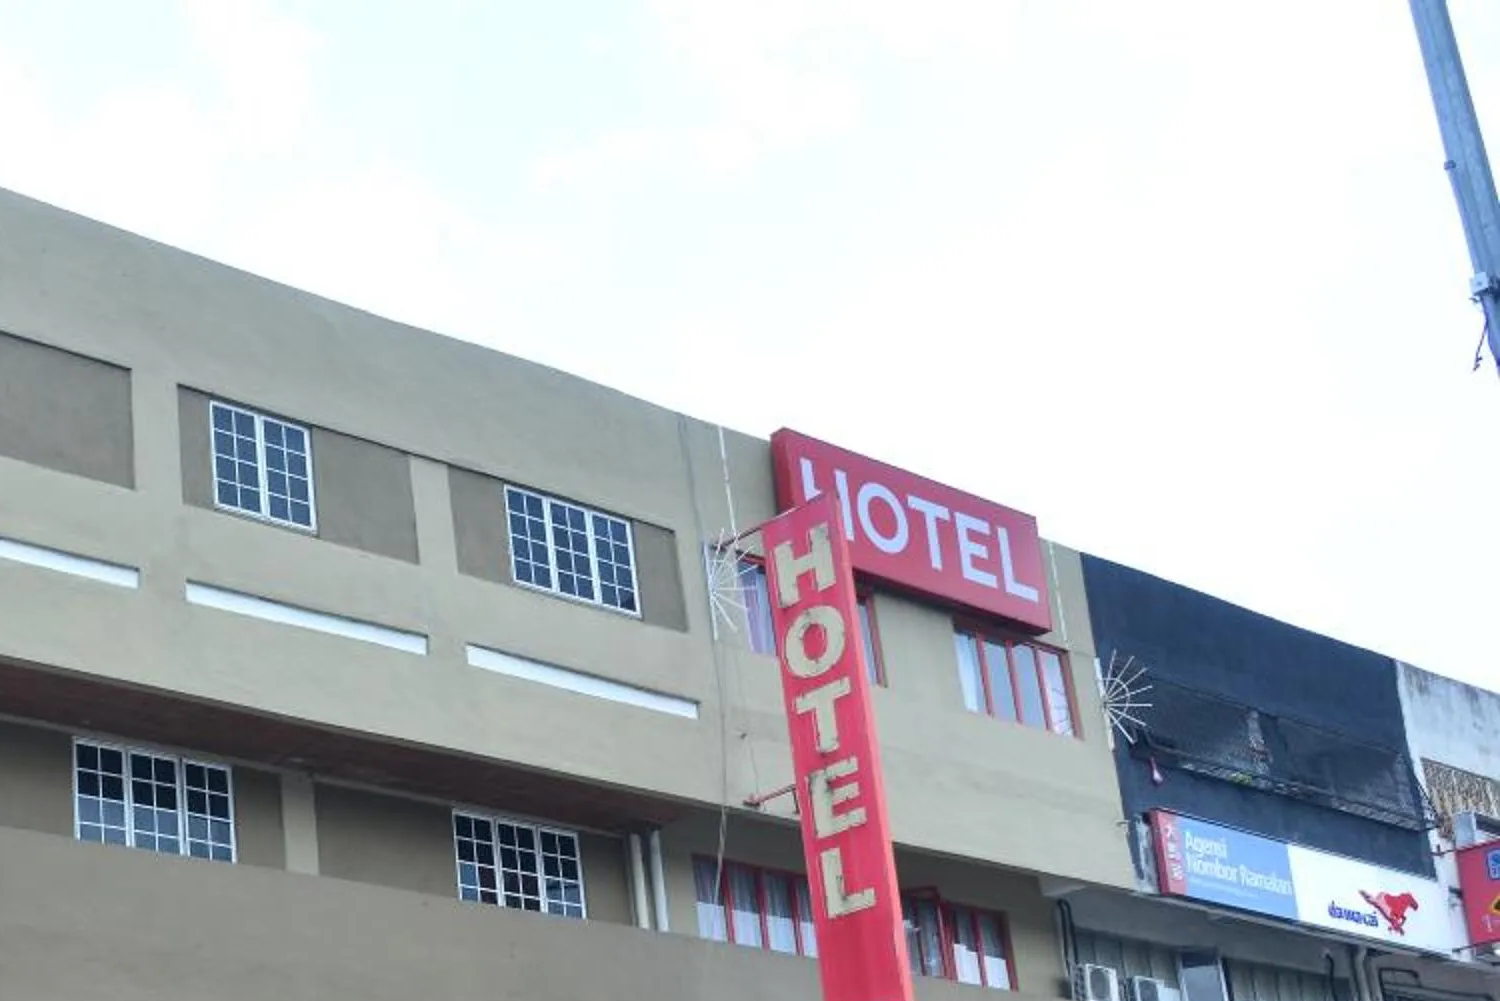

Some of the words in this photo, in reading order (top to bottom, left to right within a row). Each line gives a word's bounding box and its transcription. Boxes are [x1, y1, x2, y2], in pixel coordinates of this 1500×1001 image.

[772, 520, 876, 920] HOTEL
[1184, 831, 1227, 857] Agensi
[1186, 856, 1238, 881] Nombor
